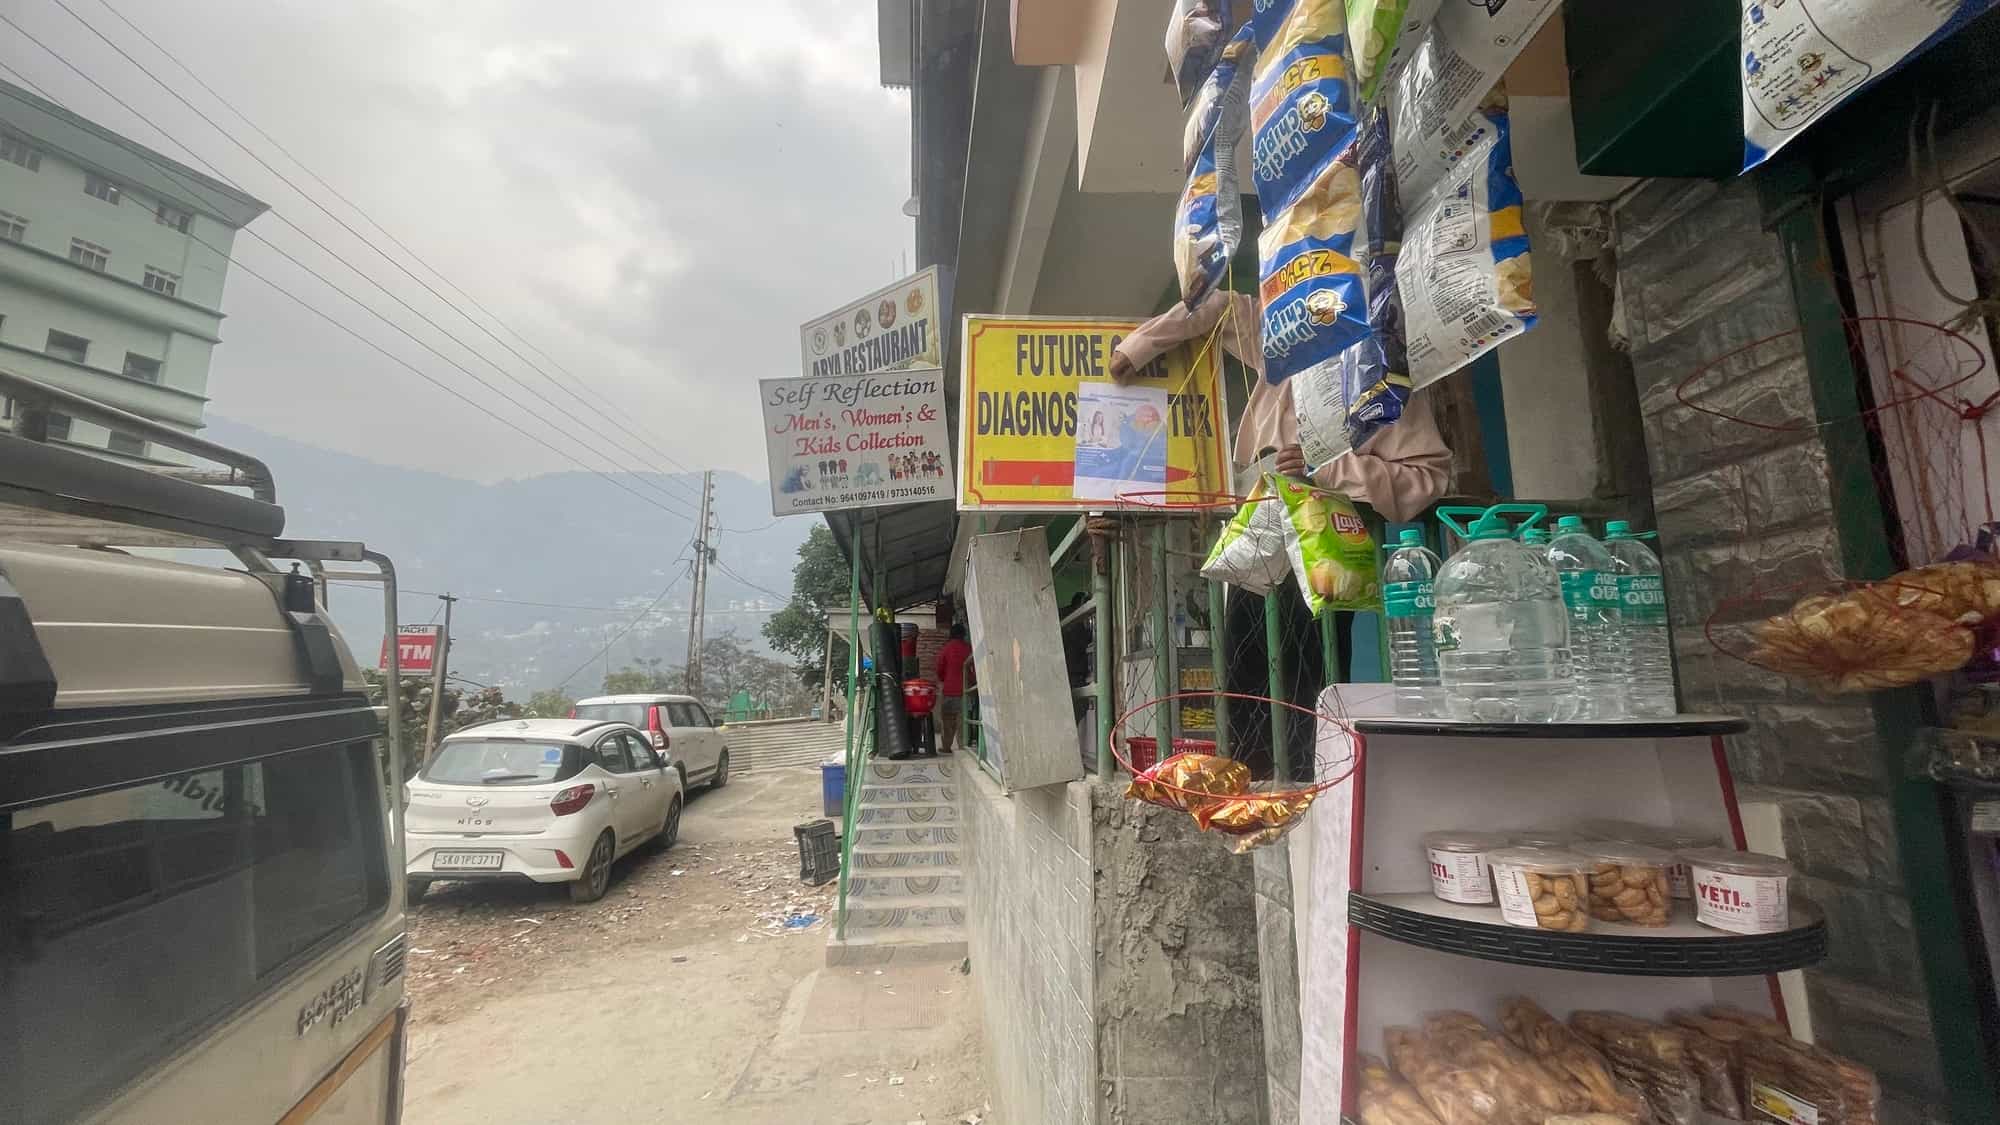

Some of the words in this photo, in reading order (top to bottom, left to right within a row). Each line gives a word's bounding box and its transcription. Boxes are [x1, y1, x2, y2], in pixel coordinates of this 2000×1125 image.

[1280, 251, 1332, 291] 25%
[1264, 298, 1308, 343] Chip
[844, 319, 928, 374] RESTAURANT
[1016, 334, 1104, 377] FUTURE
[769, 382, 820, 410] Self
[823, 378, 937, 407] Reflection
[774, 411, 836, 434] Men's,
[841, 405, 913, 428] Women's
[917, 403, 937, 422] &
[977, 391, 1079, 437] DIAGNOS
[1167, 394, 1213, 438] TER
[794, 436, 841, 456] Kids
[846, 432, 925, 452] Collection
[792, 496, 823, 507] Contact
[399, 626, 428, 634] TACHI
[400, 644, 432, 660] TM
[457, 818, 493, 826] NIOS
[1431, 862, 1447, 878] ETI
[1697, 881, 1740, 907] YETI
